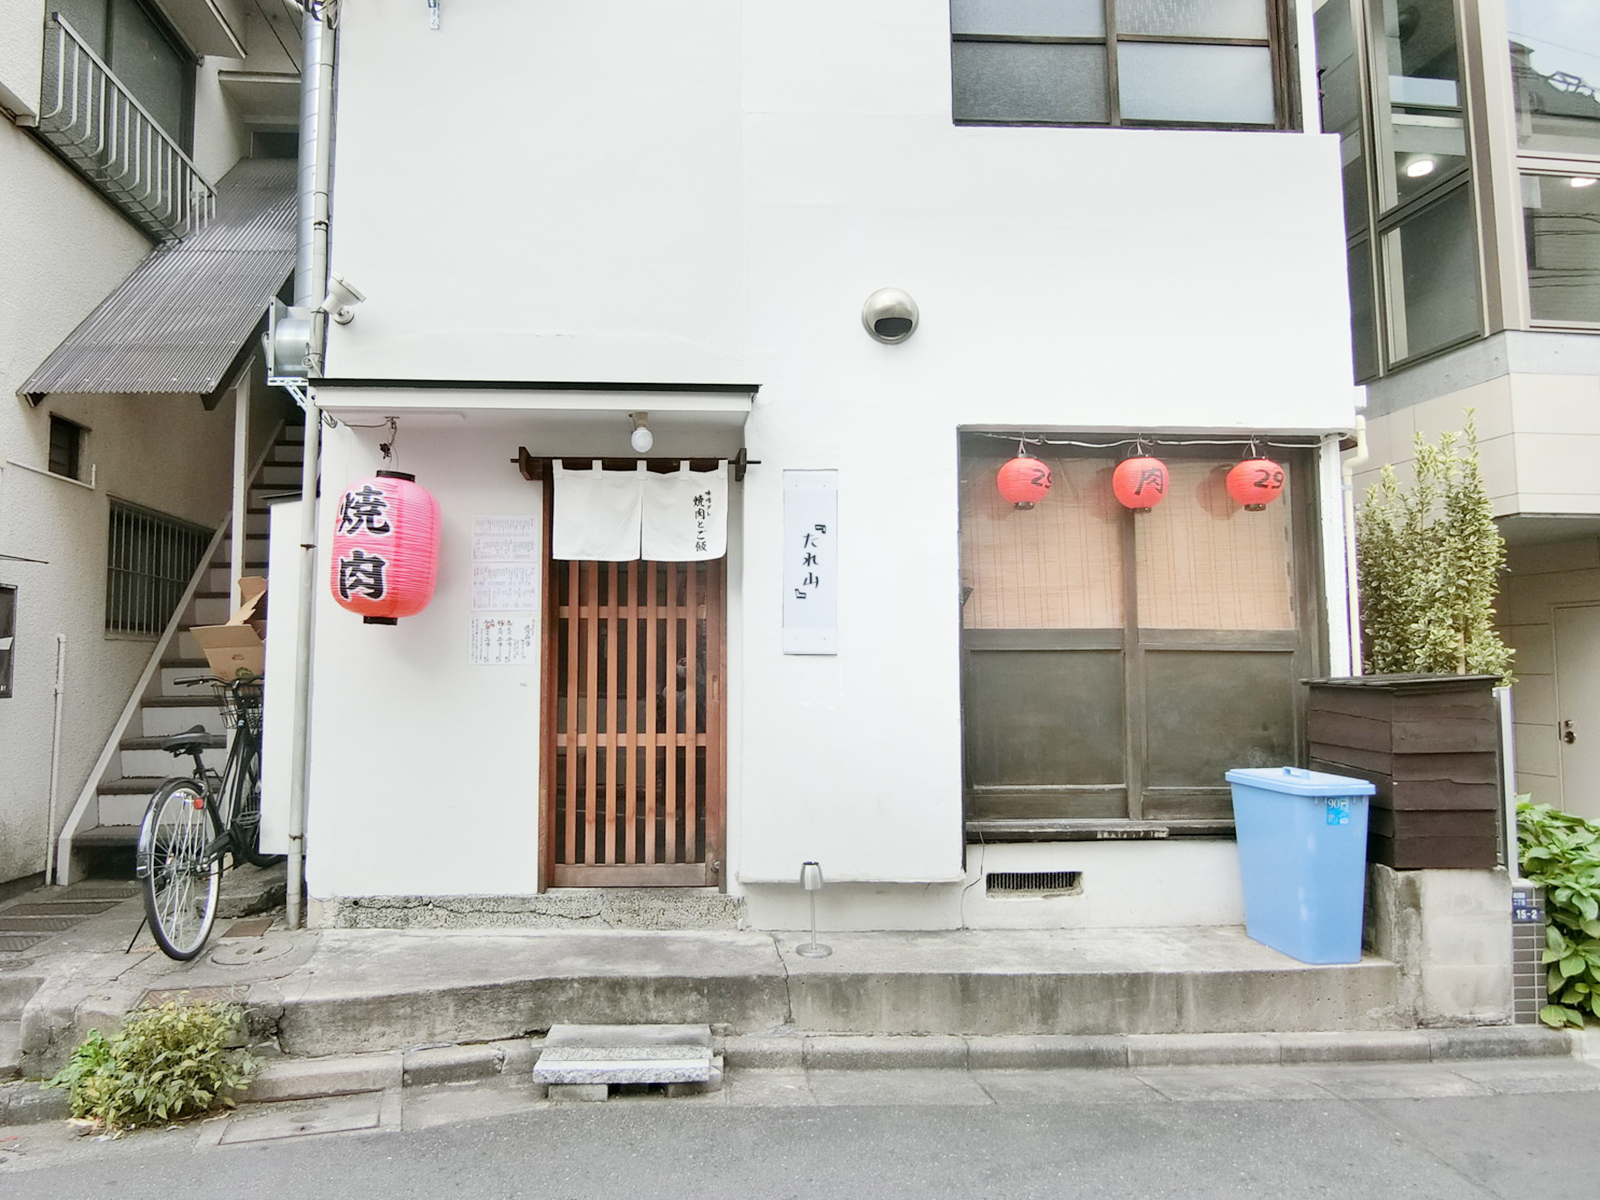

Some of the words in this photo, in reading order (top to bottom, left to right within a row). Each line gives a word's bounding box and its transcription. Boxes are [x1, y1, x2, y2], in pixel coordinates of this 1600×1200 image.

[1134, 467, 1164, 496] 肉
[1253, 468, 1284, 490] 29
[693, 495, 708, 552] 焼肉とご飯
[338, 485, 390, 599] 焼肉
[1516, 909, 1538, 920] 15-2
